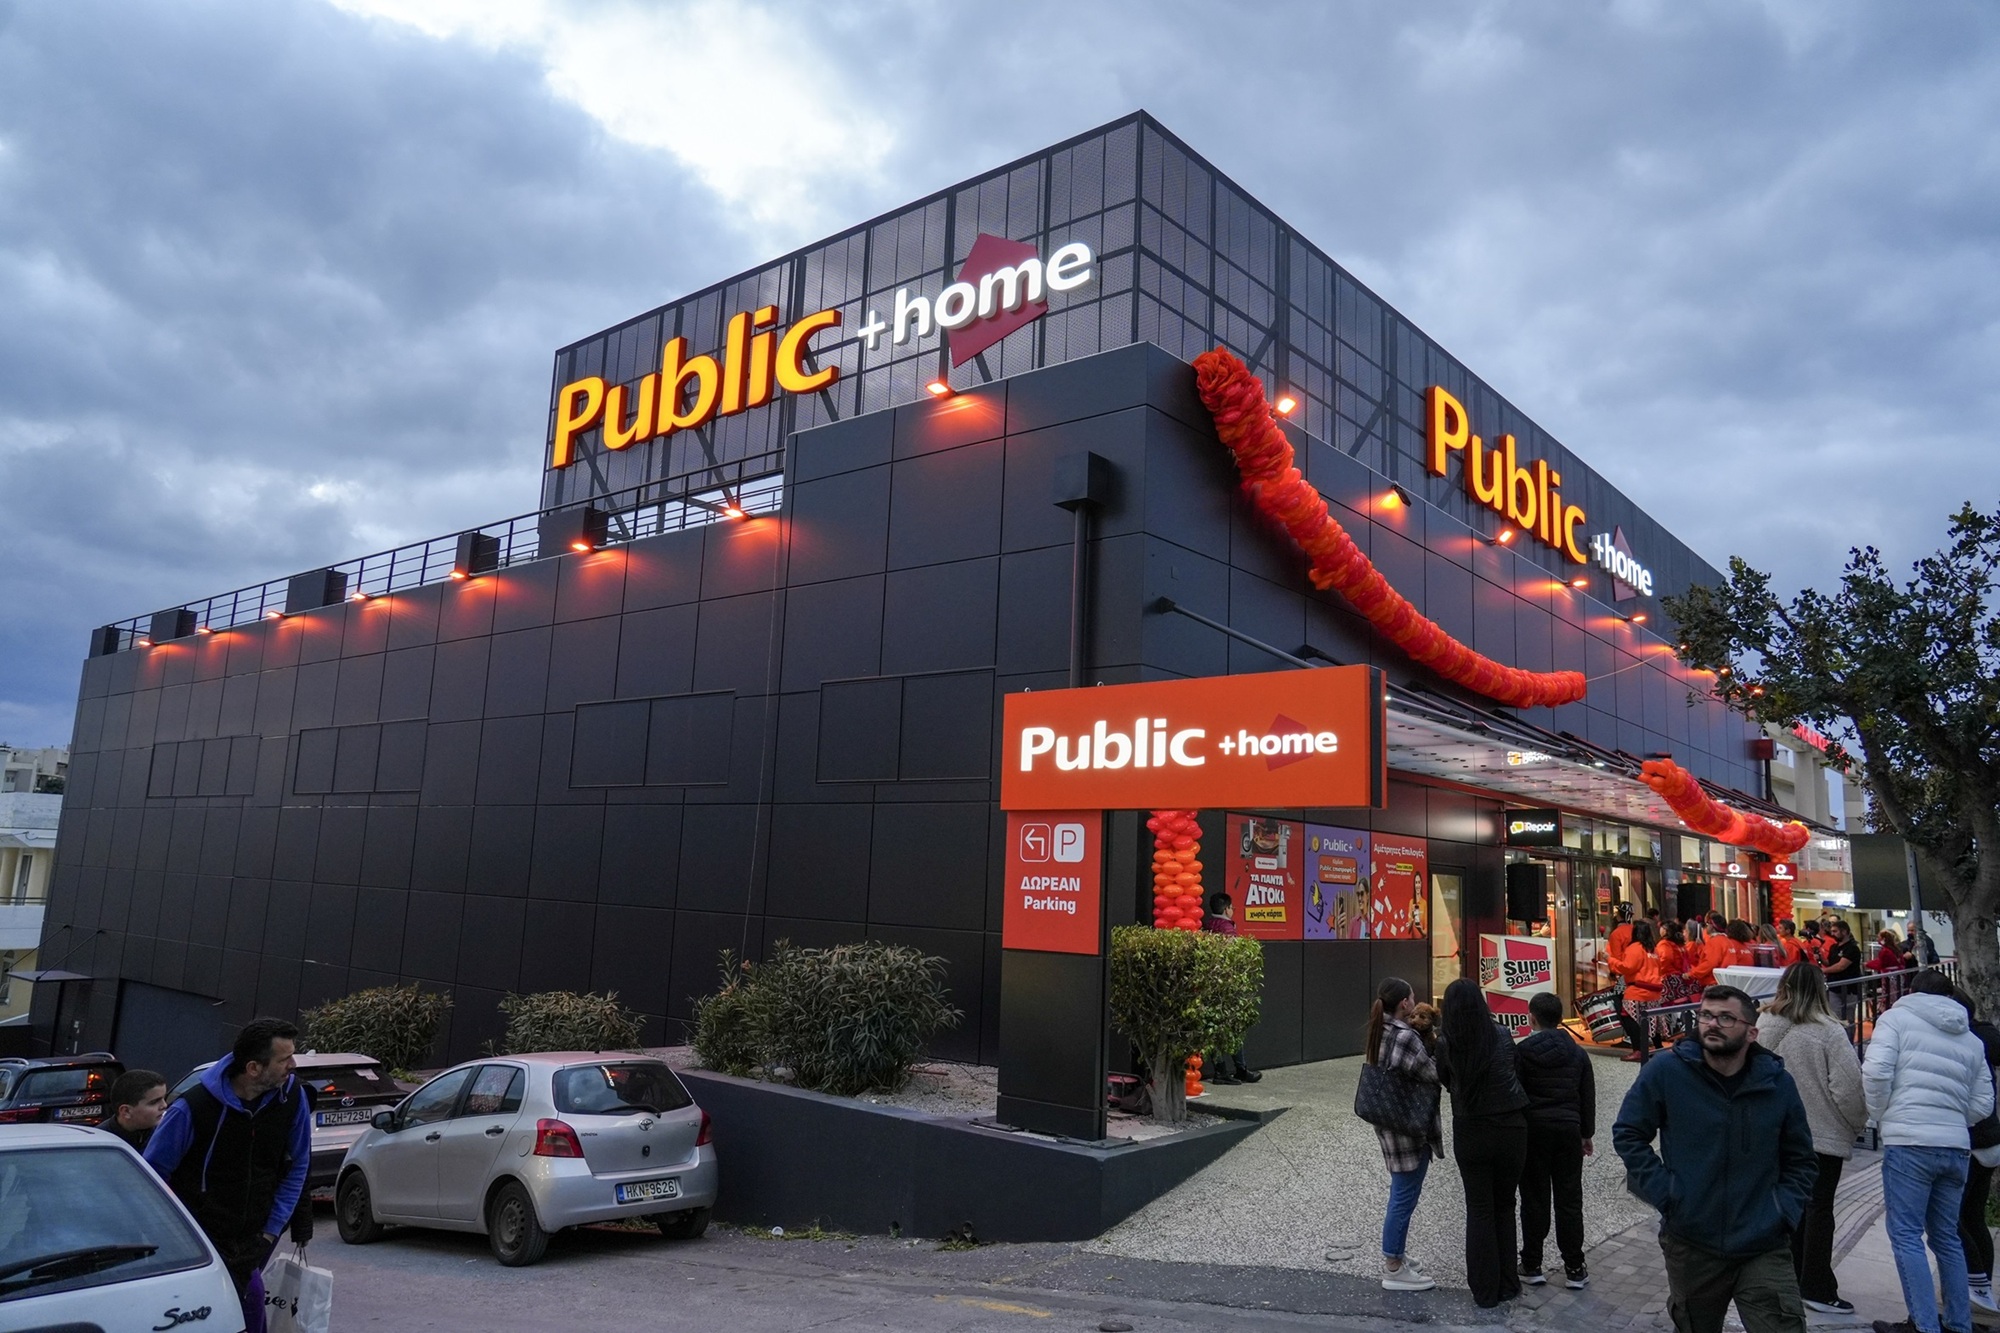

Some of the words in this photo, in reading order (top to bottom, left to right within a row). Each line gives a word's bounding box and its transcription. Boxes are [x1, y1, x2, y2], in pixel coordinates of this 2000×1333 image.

[552, 305, 842, 470] Public
[1426, 385, 1587, 565] Public
[1020, 717, 1206, 772] Public
[1061, 829, 1077, 856] P
[1020, 876, 1081, 891] ΔΩΡΕΑΝ
[1245, 883, 1285, 906] ΑΤΟΚΑ
[1024, 895, 1077, 915] Parking
[1503, 960, 1551, 977] Super
[1506, 974, 1531, 987] 904
[1490, 1013, 1528, 1031] upe
[152, 1305, 212, 1331] Saxo
